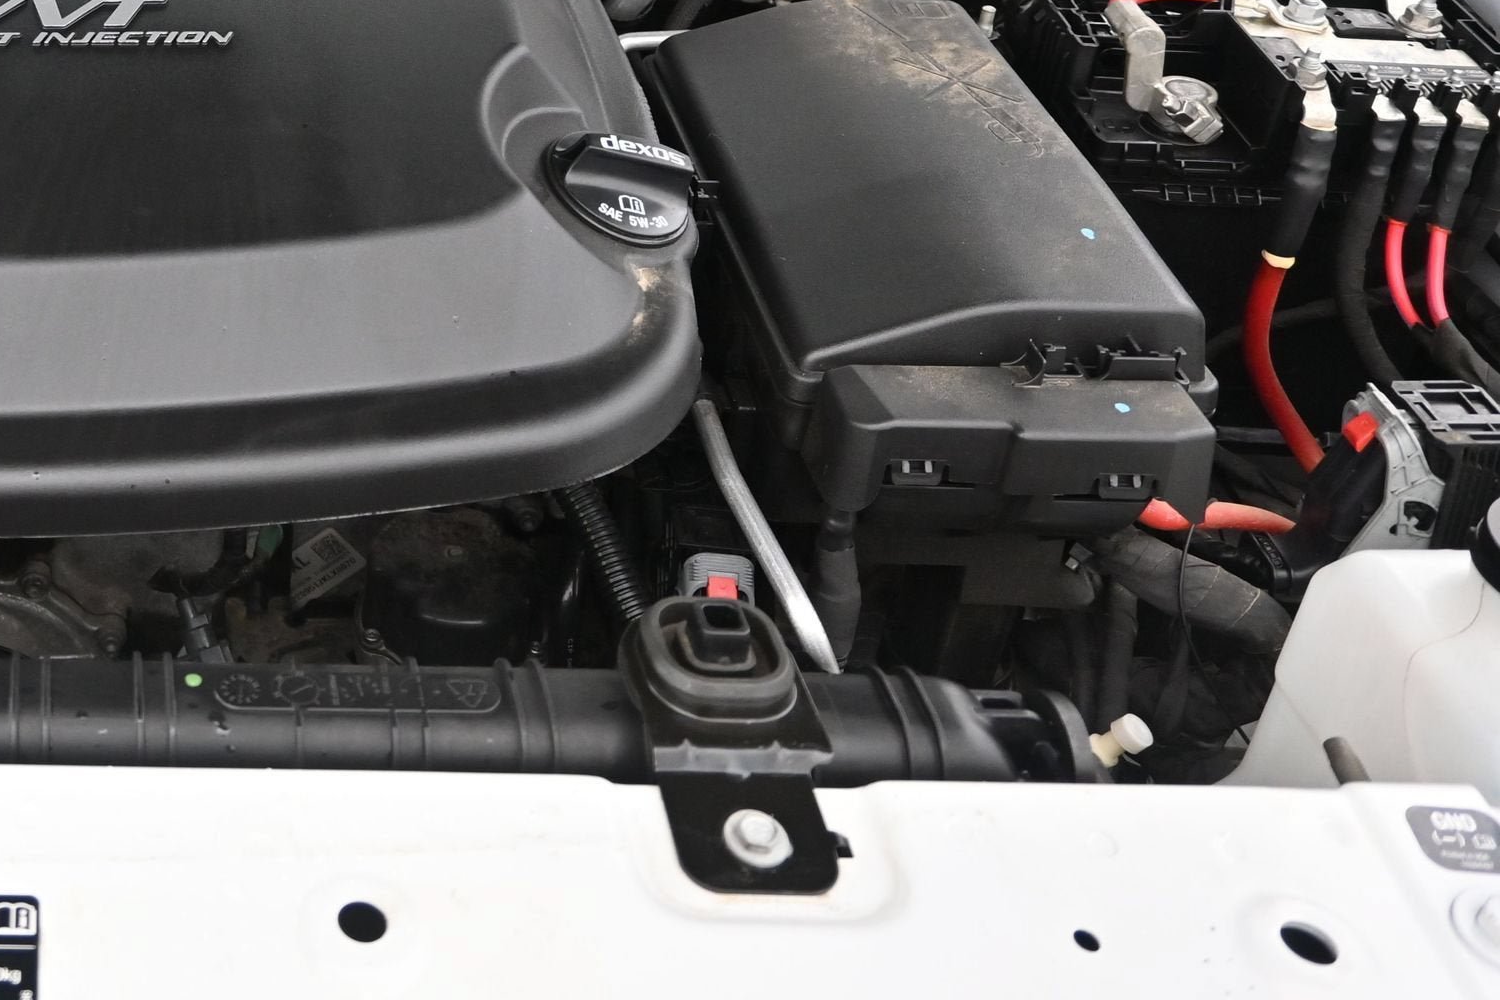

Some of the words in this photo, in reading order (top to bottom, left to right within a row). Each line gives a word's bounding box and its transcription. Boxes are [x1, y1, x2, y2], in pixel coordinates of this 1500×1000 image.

[32, 30, 234, 47] INJECTION
[599, 134, 686, 167] dexos
[597, 202, 624, 223] SAE
[628, 214, 669, 230] 5W-30
